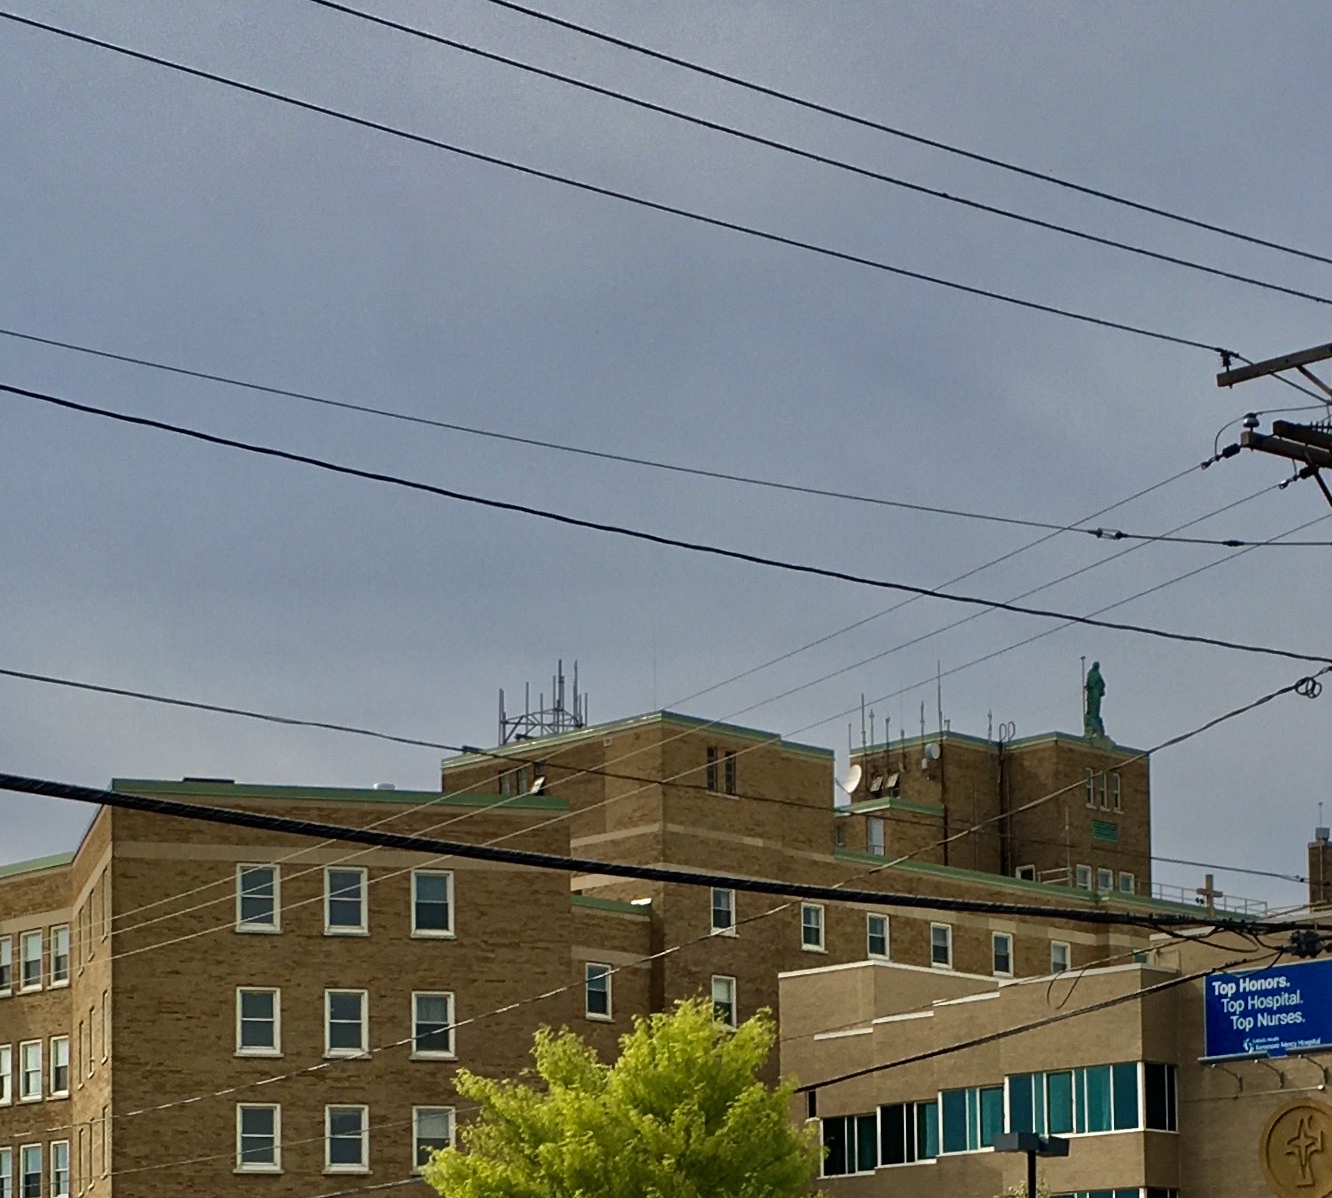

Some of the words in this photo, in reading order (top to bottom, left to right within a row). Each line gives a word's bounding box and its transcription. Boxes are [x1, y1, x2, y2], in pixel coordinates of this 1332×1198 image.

[1212, 981, 1236, 997] Top
[1239, 975, 1291, 992] Honors.
[1221, 998, 1245, 1015] Top
[1247, 989, 1304, 1011] Hospital.
[1230, 1015, 1254, 1032] Top
[1257, 1009, 1306, 1028] Nurses.
